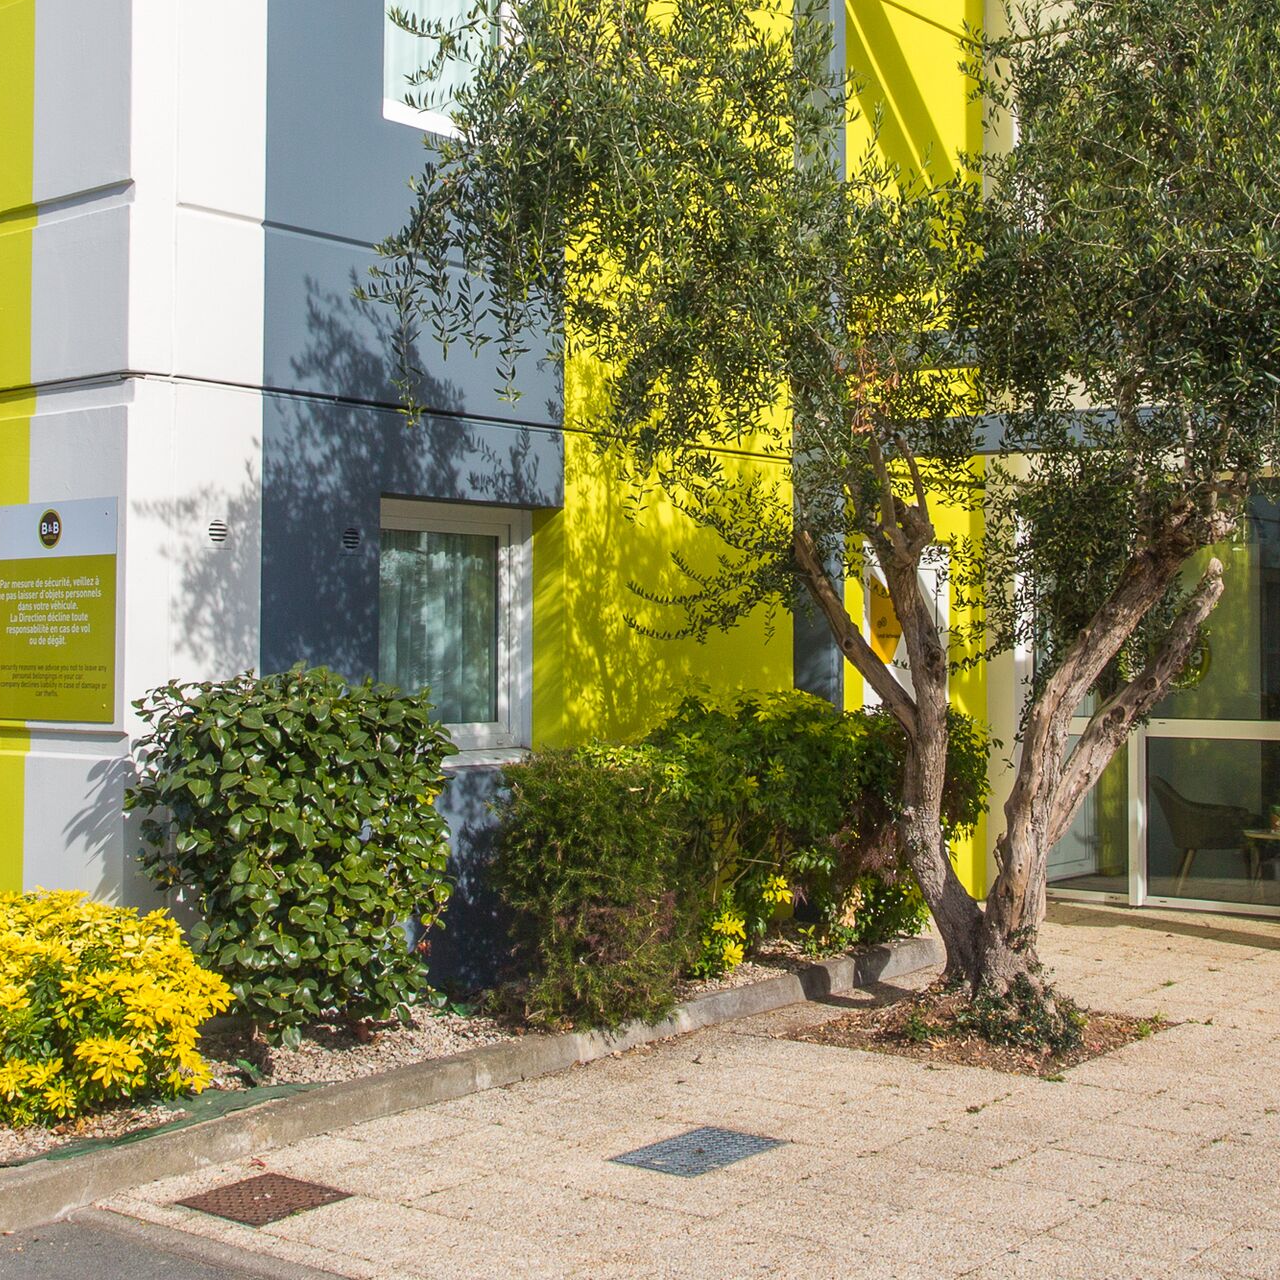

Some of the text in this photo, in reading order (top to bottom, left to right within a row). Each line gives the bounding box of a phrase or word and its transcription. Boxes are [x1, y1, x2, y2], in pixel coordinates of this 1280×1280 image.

[0, 580, 10, 588] Par
[12, 580, 34, 588] mesure
[35, 579, 43, 588] de
[6, 592, 16, 601] pas
[18, 591, 38, 599] laisser
[66, 588, 101, 600] personnels
[18, 602, 32, 610] dans
[19, 614, 46, 622] Direction
[48, 613, 70, 622] décline
